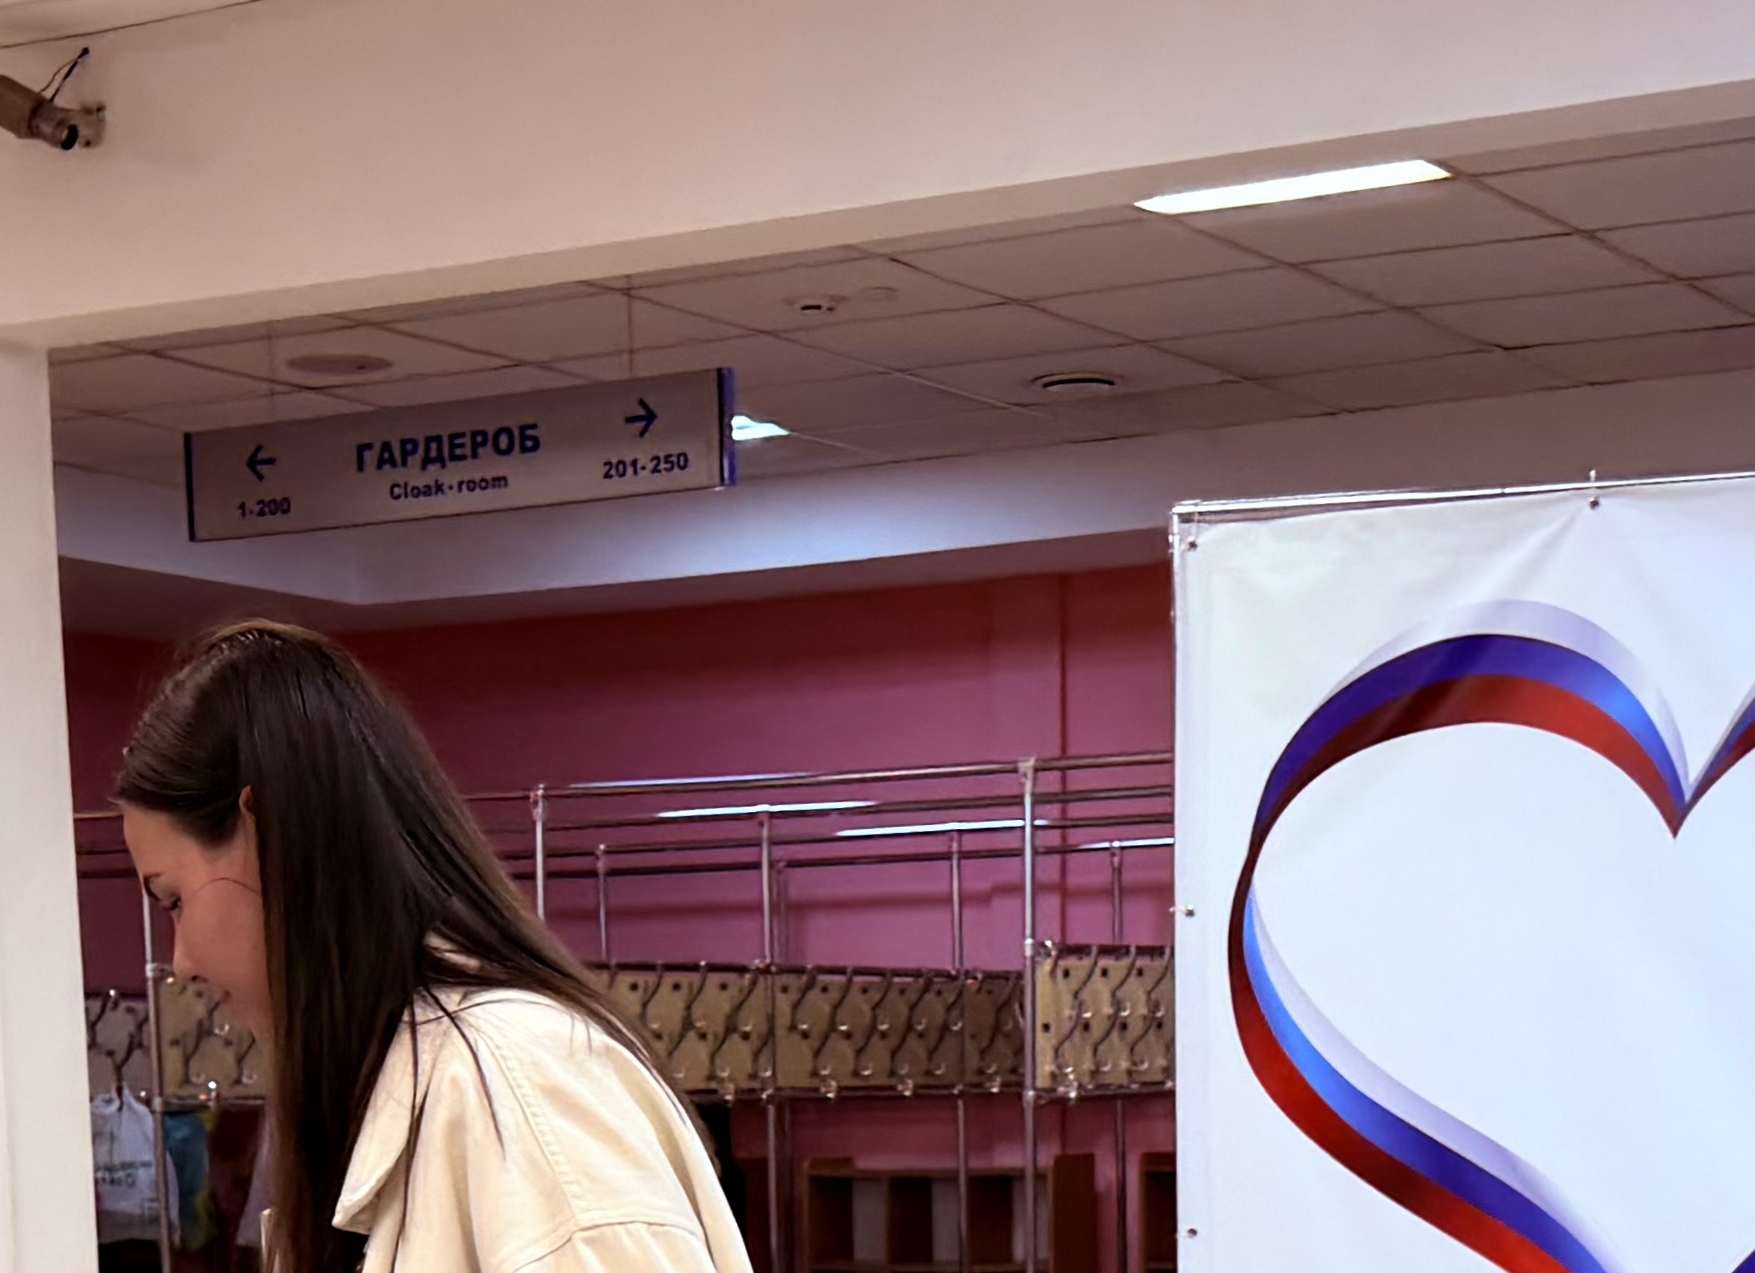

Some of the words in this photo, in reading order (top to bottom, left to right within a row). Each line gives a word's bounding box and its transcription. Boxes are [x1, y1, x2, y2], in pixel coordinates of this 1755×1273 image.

[356, 423, 541, 472] ГАРДЕРОБ
[603, 452, 689, 479] 201-250
[389, 475, 509, 501] Cloak-room
[238, 496, 291, 519] 1-200
